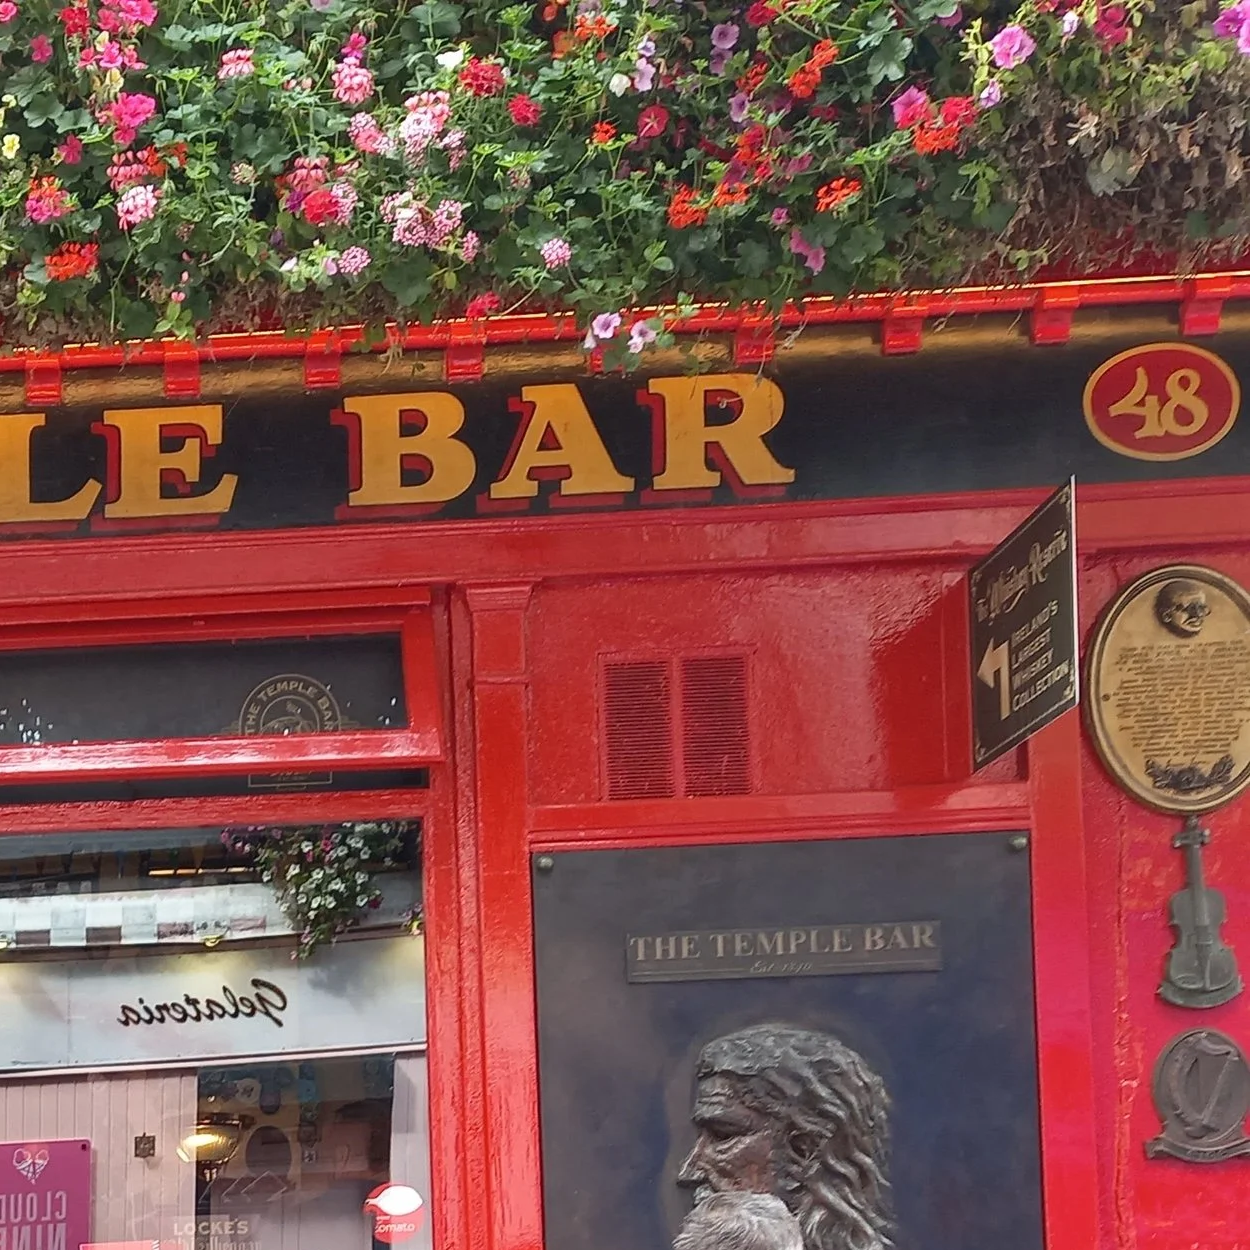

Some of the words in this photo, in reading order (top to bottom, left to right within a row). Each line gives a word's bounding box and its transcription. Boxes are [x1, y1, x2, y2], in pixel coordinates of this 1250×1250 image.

[1109, 366, 1209, 438] 48
[332, 373, 796, 520] BAR
[245, 702, 261, 735] THE
[256, 681, 318, 701] TEMPLE
[317, 695, 334, 731] BAR
[630, 935, 700, 961] THE
[710, 928, 853, 958] TEMPLE
[863, 924, 937, 951] BAR
[173, 1218, 249, 1236] LOCKE'S
